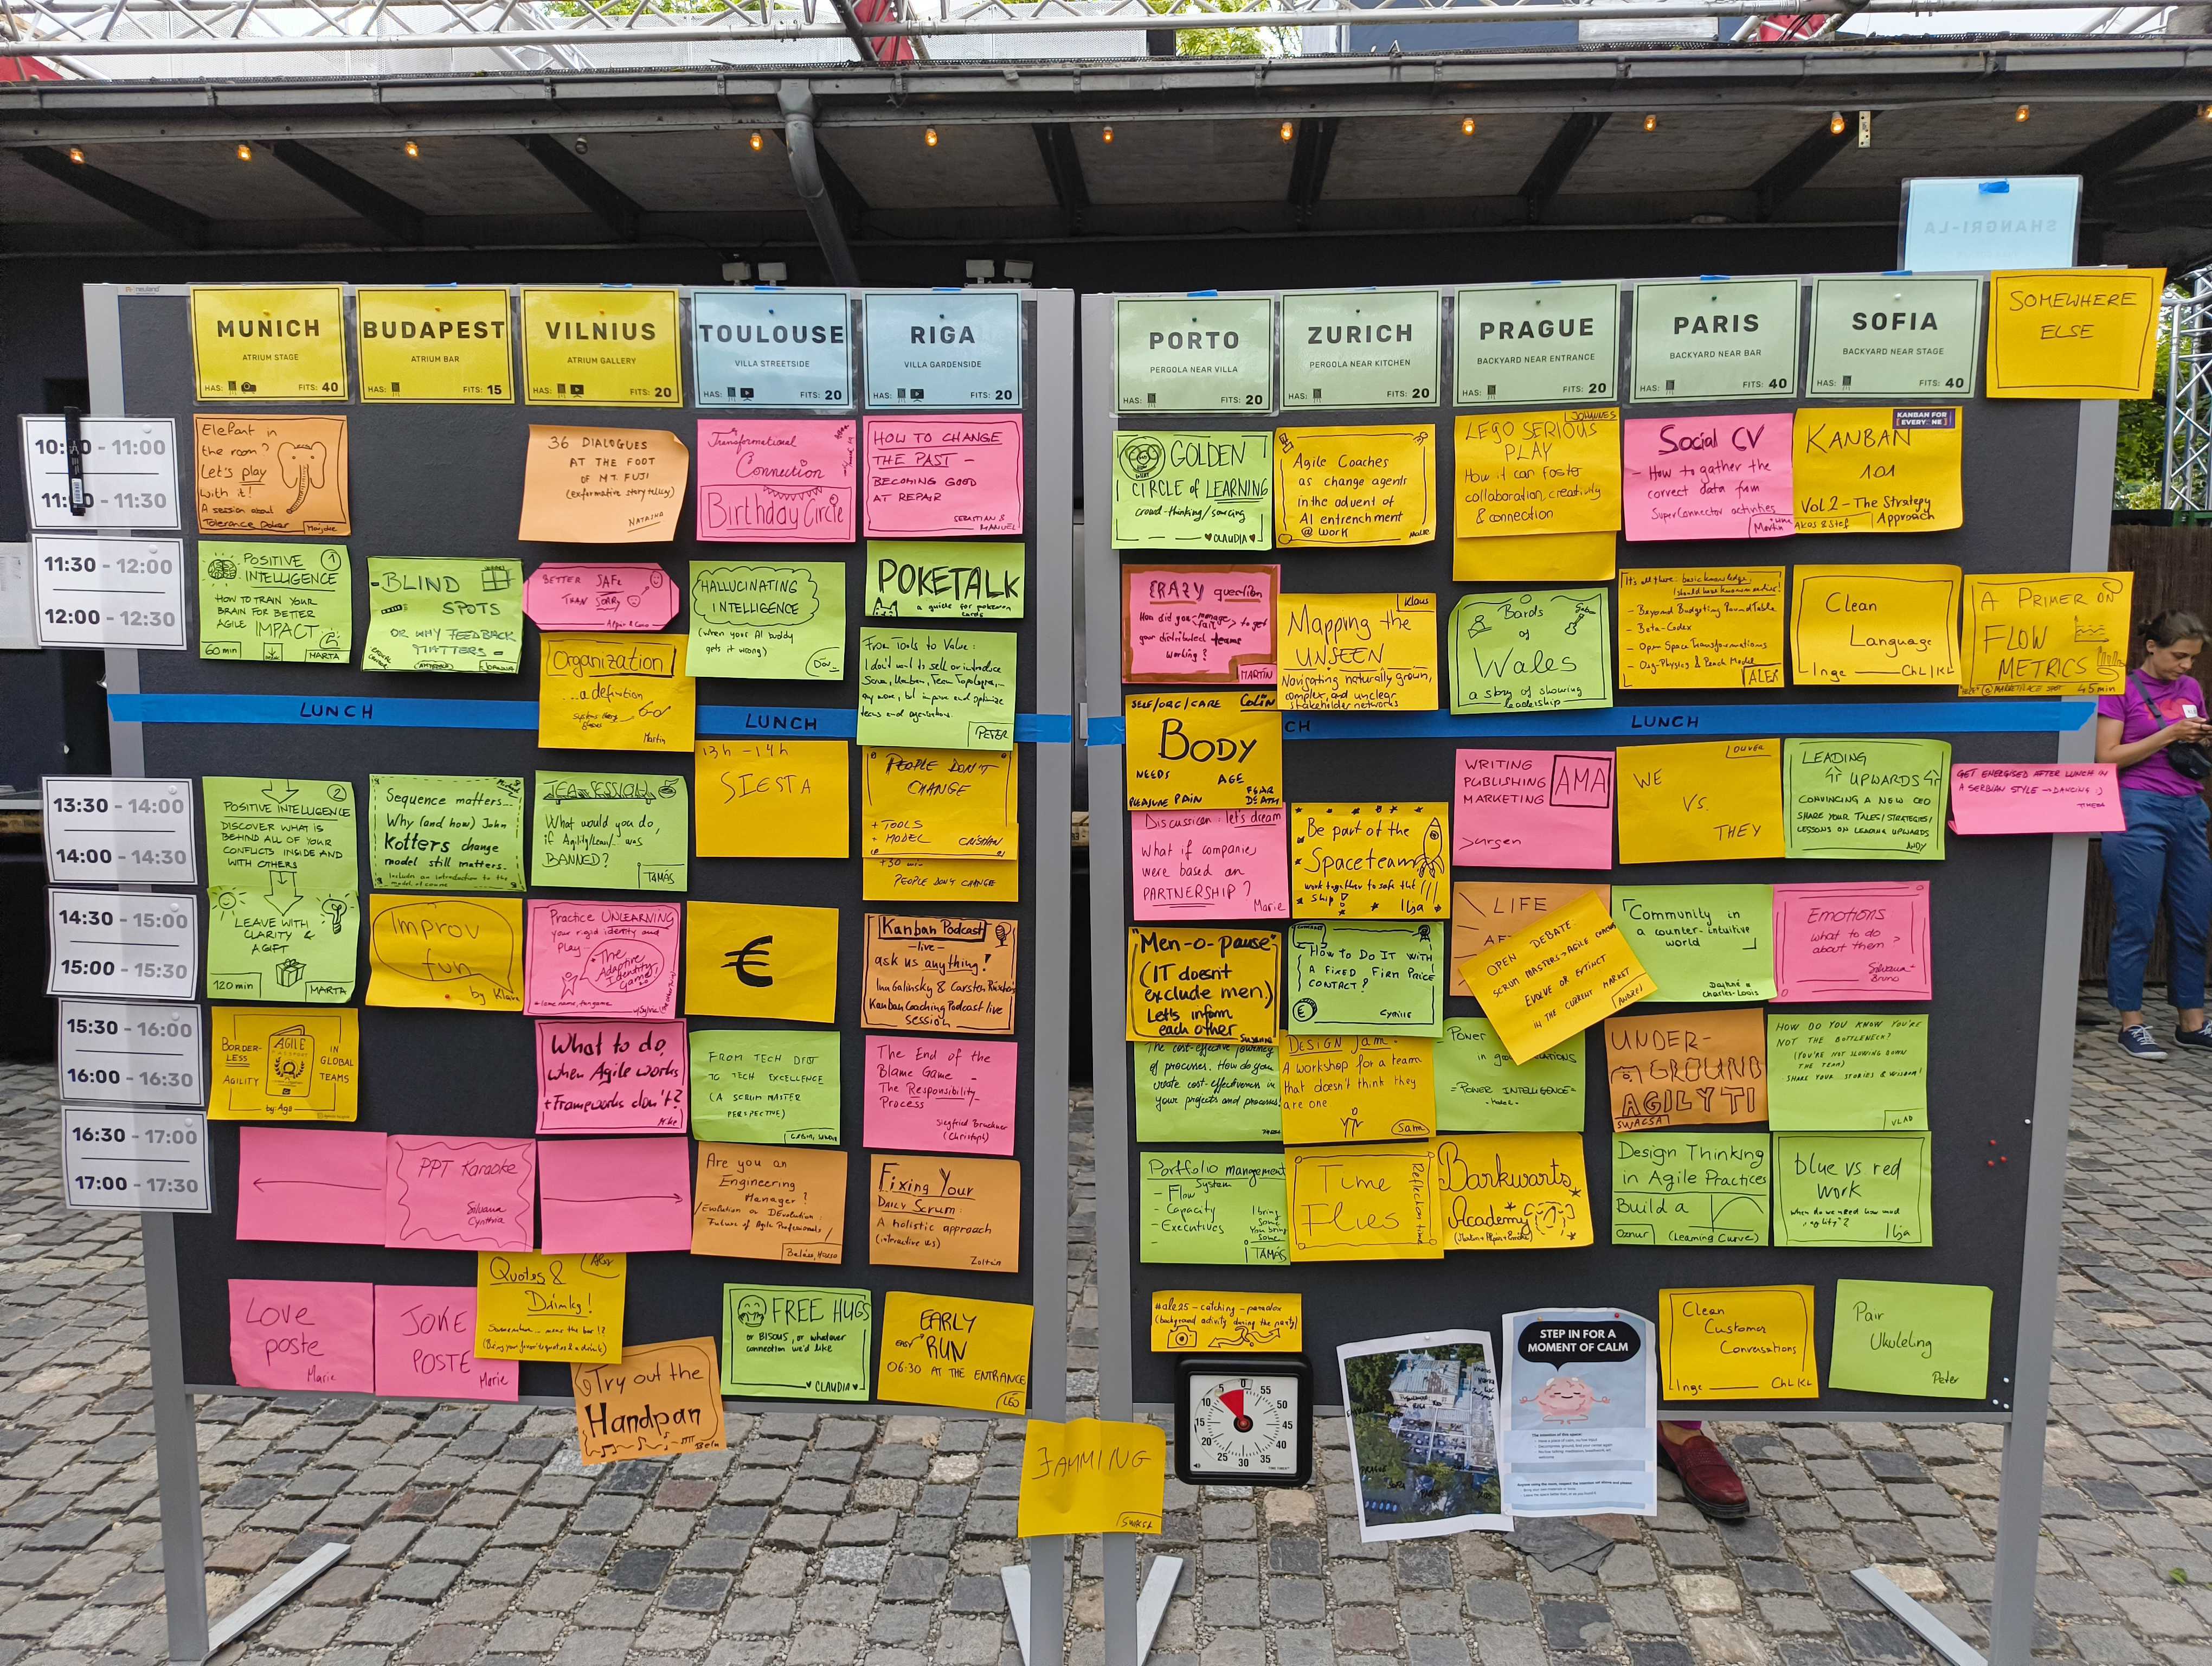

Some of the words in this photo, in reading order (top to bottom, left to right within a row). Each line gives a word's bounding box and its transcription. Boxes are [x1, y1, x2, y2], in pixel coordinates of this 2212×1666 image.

[2010, 291, 2136, 311] SOMEWHERE
[217, 319, 319, 337] MUNICH
[364, 322, 504, 338] BUDAPEST
[1481, 318, 1593, 339] PRAGUE
[1675, 315, 1758, 334] PARIS
[1853, 313, 1937, 330] SOFIA
[545, 322, 655, 340] VILNIUS
[699, 325, 843, 343] TOULOUSE
[911, 326, 975, 343] RIGA
[1308, 324, 1411, 344] ZURICH
[2041, 325, 2094, 339] ELSE
[1150, 331, 1238, 349] PORTO
[1477, 356, 1521, 364] BACKYARD
[1524, 355, 1547, 363] NEAR
[1549, 353, 1595, 362] ENTRANCE
[1670, 351, 1715, 359] BACKYARD
[1843, 348, 1888, 356] BACKYARD
[1150, 366, 1187, 374] PERGOLA
[1309, 360, 1347, 368] PERGOLA
[1374, 359, 1410, 367] KITCHEN
[322, 382, 338, 393] 40
[1639, 385, 1660, 393] HAS:
[1742, 380, 1764, 388] FITS:
[1769, 378, 1787, 389] 40
[874, 431, 907, 445] HOW
[913, 432, 932, 444] TO
[942, 432, 1002, 442] CHANGE
[1658, 425, 1718, 455] Social
[1732, 425, 1764, 451] CV
[1806, 424, 1912, 454] KANBAN
[873, 454, 909, 469] THE
[914, 452, 950, 468] PAST
[1171, 440, 1245, 467] GOLDEN
[736, 452, 825, 478] Connection
[1860, 464, 1894, 479] 101
[1133, 480, 1184, 498] CIRCLE
[1189, 479, 1203, 496] of
[1206, 478, 1268, 501] LEARNING
[708, 492, 798, 530] Birthday
[804, 498, 843, 527] Circle
[44, 556, 95, 572] 11:30
[117, 559, 172, 574] 12:00
[244, 553, 303, 567] POSITIVE
[246, 571, 338, 585] INTELLIGENCE
[382, 575, 459, 592] BLIND
[442, 601, 500, 615] SPOTS
[45, 609, 100, 624] 12:00
[120, 611, 174, 626] 12:30
[1984, 625, 2047, 653] FLOW
[1474, 648, 1577, 678] Wales
[1998, 657, 2086, 681] METRICS
[1158, 719, 1257, 763] BODY
[1464, 759, 1532, 771] WRITING
[1802, 752, 1866, 766] LEADING
[1464, 777, 1546, 787] PUBLISHING
[1555, 766, 1605, 795] AMA
[1634, 769, 1661, 788] WE
[1850, 772, 1919, 786] UPWARDS
[721, 772, 811, 804] SIESTA
[54, 798, 108, 812] 13:30
[128, 799, 183, 813] 14:00
[1463, 794, 1544, 805] MARKETING
[1713, 823, 1761, 841] THEY
[1304, 847, 1416, 877] Spaceteam
[60, 910, 113, 925] 14:30
[133, 913, 187, 928] 15:00
[391, 911, 479, 940] Improv
[878, 1047, 905, 1060] The
[916, 1047, 936, 1060] End
[948, 1048, 961, 1062] of
[971, 1051, 990, 1062] the
[223, 1075, 259, 1087] AGILITY
[319, 1072, 349, 1084] TEAMS
[73, 1127, 125, 1142] 16:30
[145, 1130, 196, 1144] 17:00
[419, 1158, 447, 1178] PPT
[1795, 1157, 1837, 1175] blue
[1874, 1158, 1901, 1178] red
[75, 1176, 127, 1190] 17:00
[147, 1178, 197, 1192] 17:30
[879, 1163, 928, 1196] Fixing
[937, 1168, 975, 1200] Your
[1318, 1164, 1391, 1193] Time
[1818, 1181, 1861, 1199] work
[773, 1298, 824, 1325] FREE
[834, 1296, 869, 1323] HUGS
[1853, 1302, 1884, 1321] Pair
[401, 1304, 467, 1336] JOKE
[1540, 1329, 1566, 1339] STEP
[1571, 1329, 1580, 1339] IN
[1583, 1329, 1604, 1338] FOR
[1606, 1329, 1616, 1338] A
[927, 1340, 967, 1362] RUN
[1528, 1342, 1576, 1353] MOMENT
[1579, 1343, 1593, 1352] OF
[1596, 1342, 1629, 1351] CALM
[1871, 1331, 1931, 1359] Ukuleling
[414, 1353, 471, 1374] POSTE
[1932, 1371, 1959, 1383] Peter
[1261, 1386, 1271, 1394] 55
[1201, 1398, 1211, 1407] 10
[1277, 1400, 1288, 1409] 50
[585, 1402, 700, 1441] Handpan
[1195, 1418, 1205, 1426] 15
[1282, 1420, 1293, 1430] 45
[1276, 1440, 1287, 1449] 40
[1238, 1458, 1249, 1467] 30
